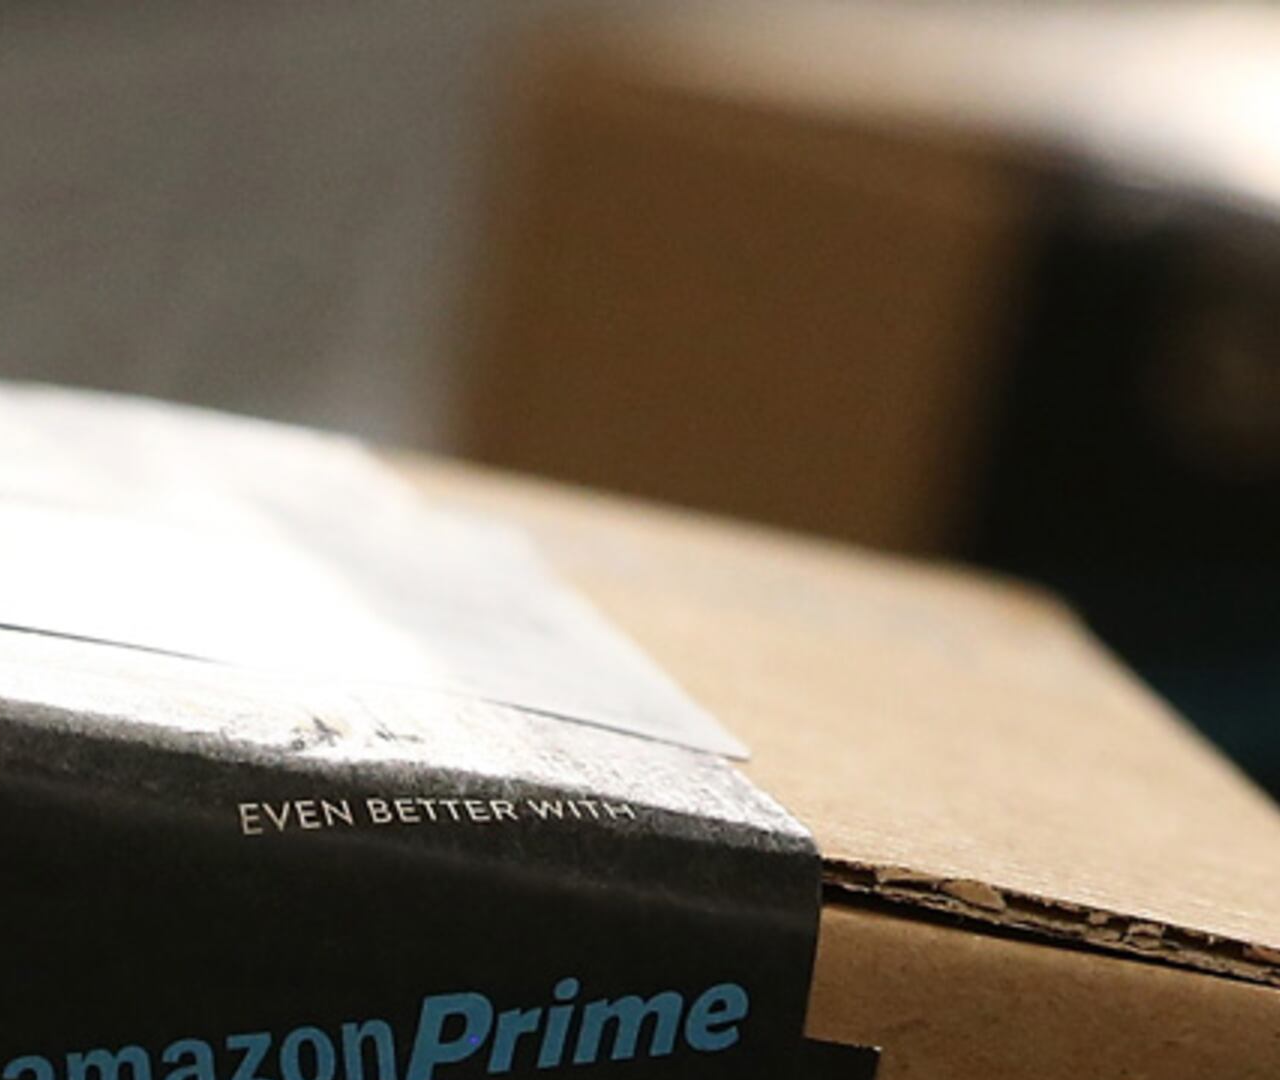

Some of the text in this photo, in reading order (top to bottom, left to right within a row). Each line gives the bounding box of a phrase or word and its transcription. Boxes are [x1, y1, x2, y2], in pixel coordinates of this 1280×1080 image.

[238, 796, 637, 835] EVEN BETTER WITH
